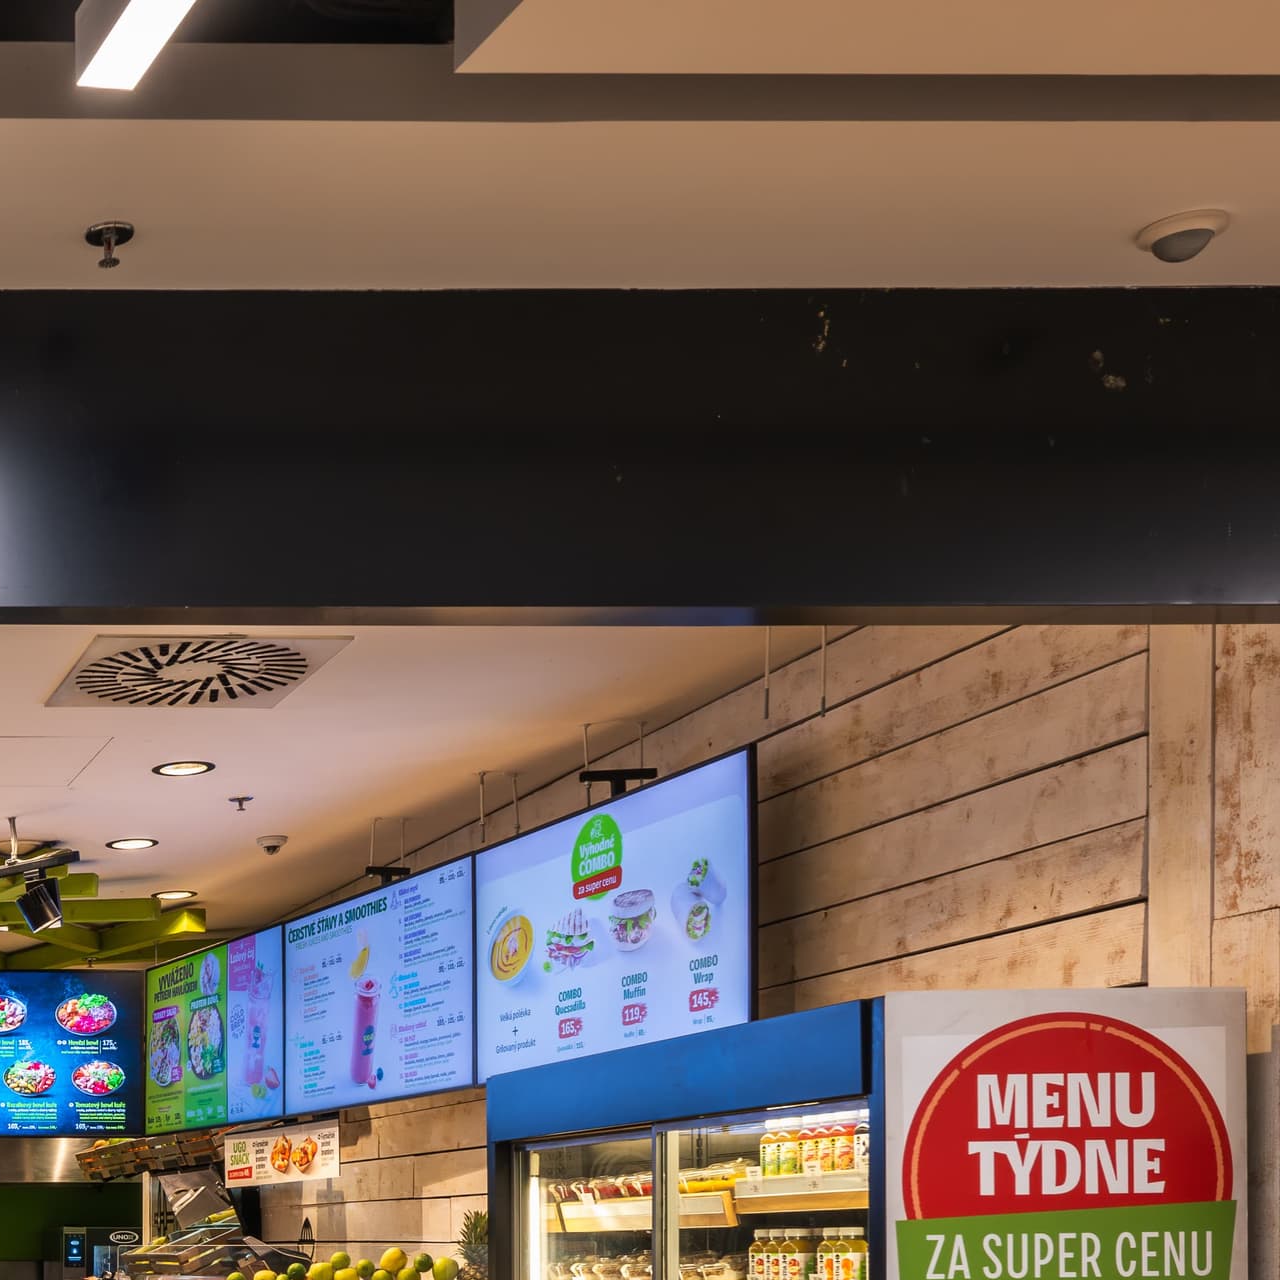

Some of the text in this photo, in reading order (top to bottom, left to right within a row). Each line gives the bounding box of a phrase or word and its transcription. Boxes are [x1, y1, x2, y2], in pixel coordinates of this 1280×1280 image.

[579, 851, 615, 876] COMBO
[585, 881, 601, 893] super
[344, 897, 388, 925] SMOOTHIES
[689, 954, 718, 971] COMBO
[622, 971, 648, 987] COMBO
[693, 972, 714, 984] Wrap
[558, 987, 582, 1002] COMBO
[623, 986, 646, 1000] Muffin
[977, 1072, 1156, 1129] MENU
[967, 1133, 1167, 1196] TÝDNE
[926, 1231, 1213, 1280] ZA SUPER CENU
